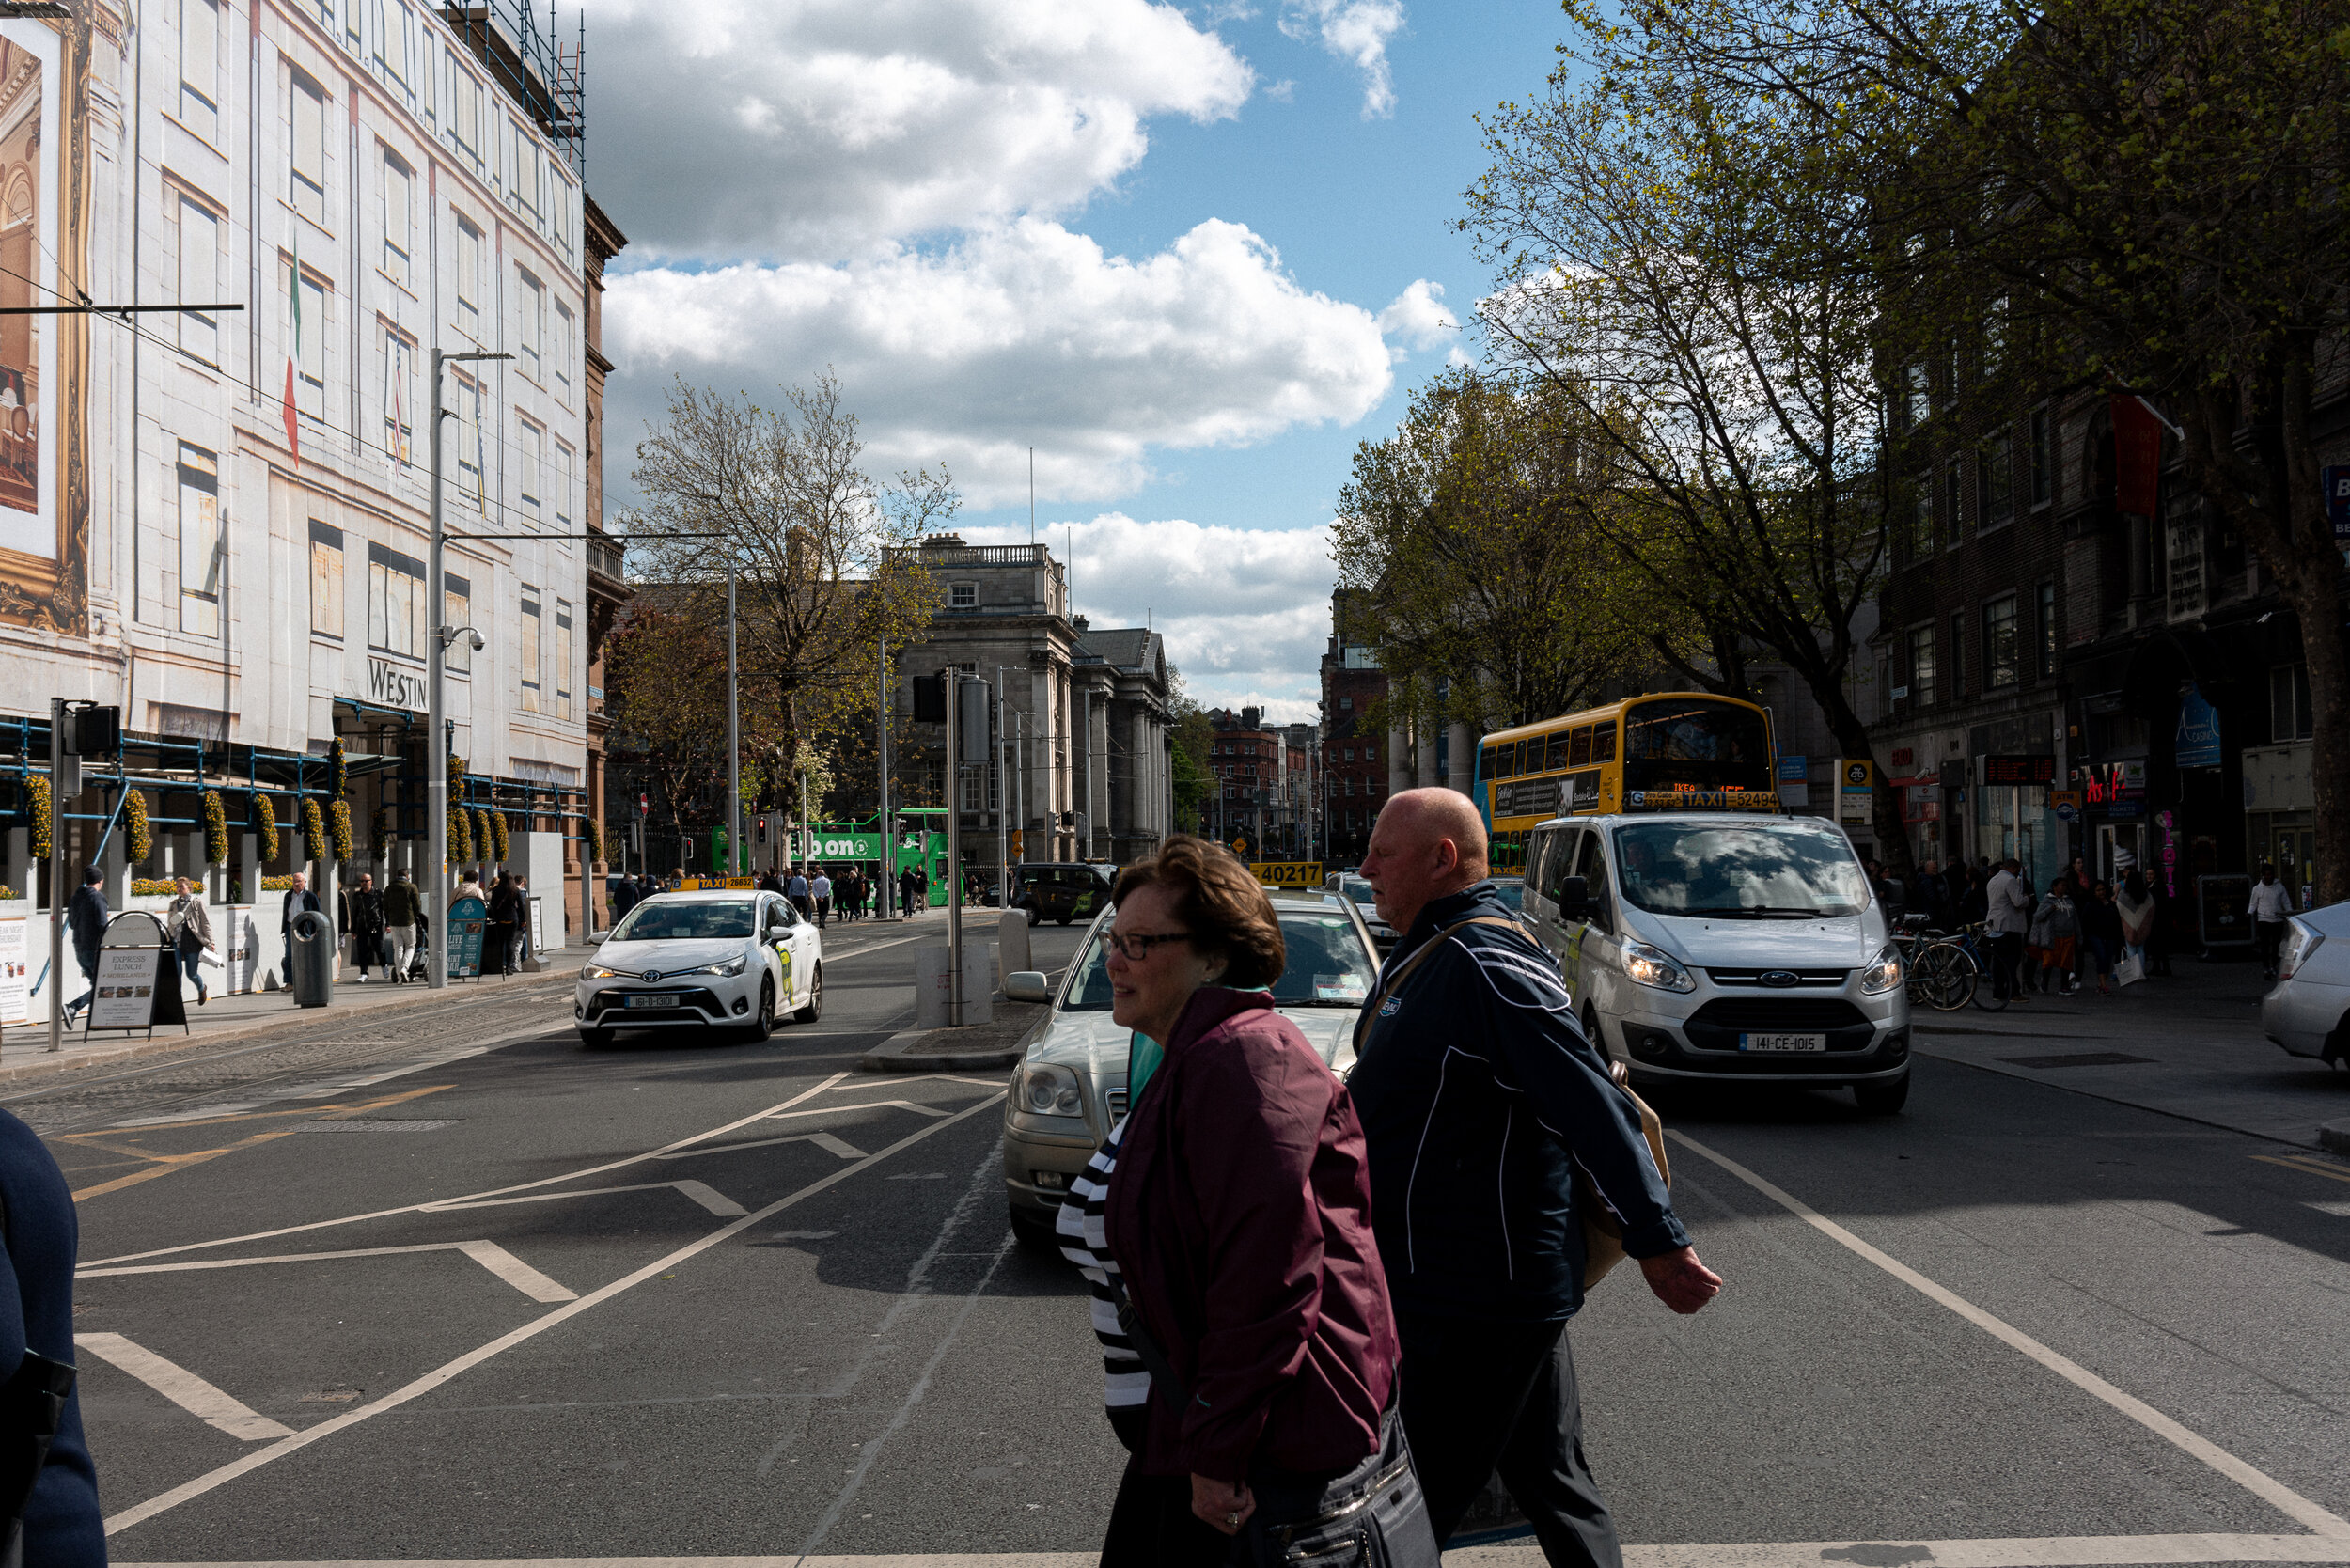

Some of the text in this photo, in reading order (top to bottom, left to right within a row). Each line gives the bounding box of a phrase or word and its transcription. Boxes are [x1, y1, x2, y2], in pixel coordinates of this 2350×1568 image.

[368, 659, 427, 708] WESTIN
[1674, 783, 1695, 792] IKEA
[1684, 793, 1722, 807] TAXI
[1737, 793, 1778, 807] 52494
[825, 839, 855, 856] on
[2163, 810, 2176, 898] SLOTS
[1261, 865, 1319, 882] 40217
[1492, 866, 1512, 875] TAXI
[673, 880, 681, 888] D
[700, 878, 725, 888] TAXI
[730, 878, 752, 886] 26652
[448, 934, 463, 944] LIVE
[112, 955, 146, 964] EXPRESS
[1756, 1037, 1815, 1050] 141-CE-1015
